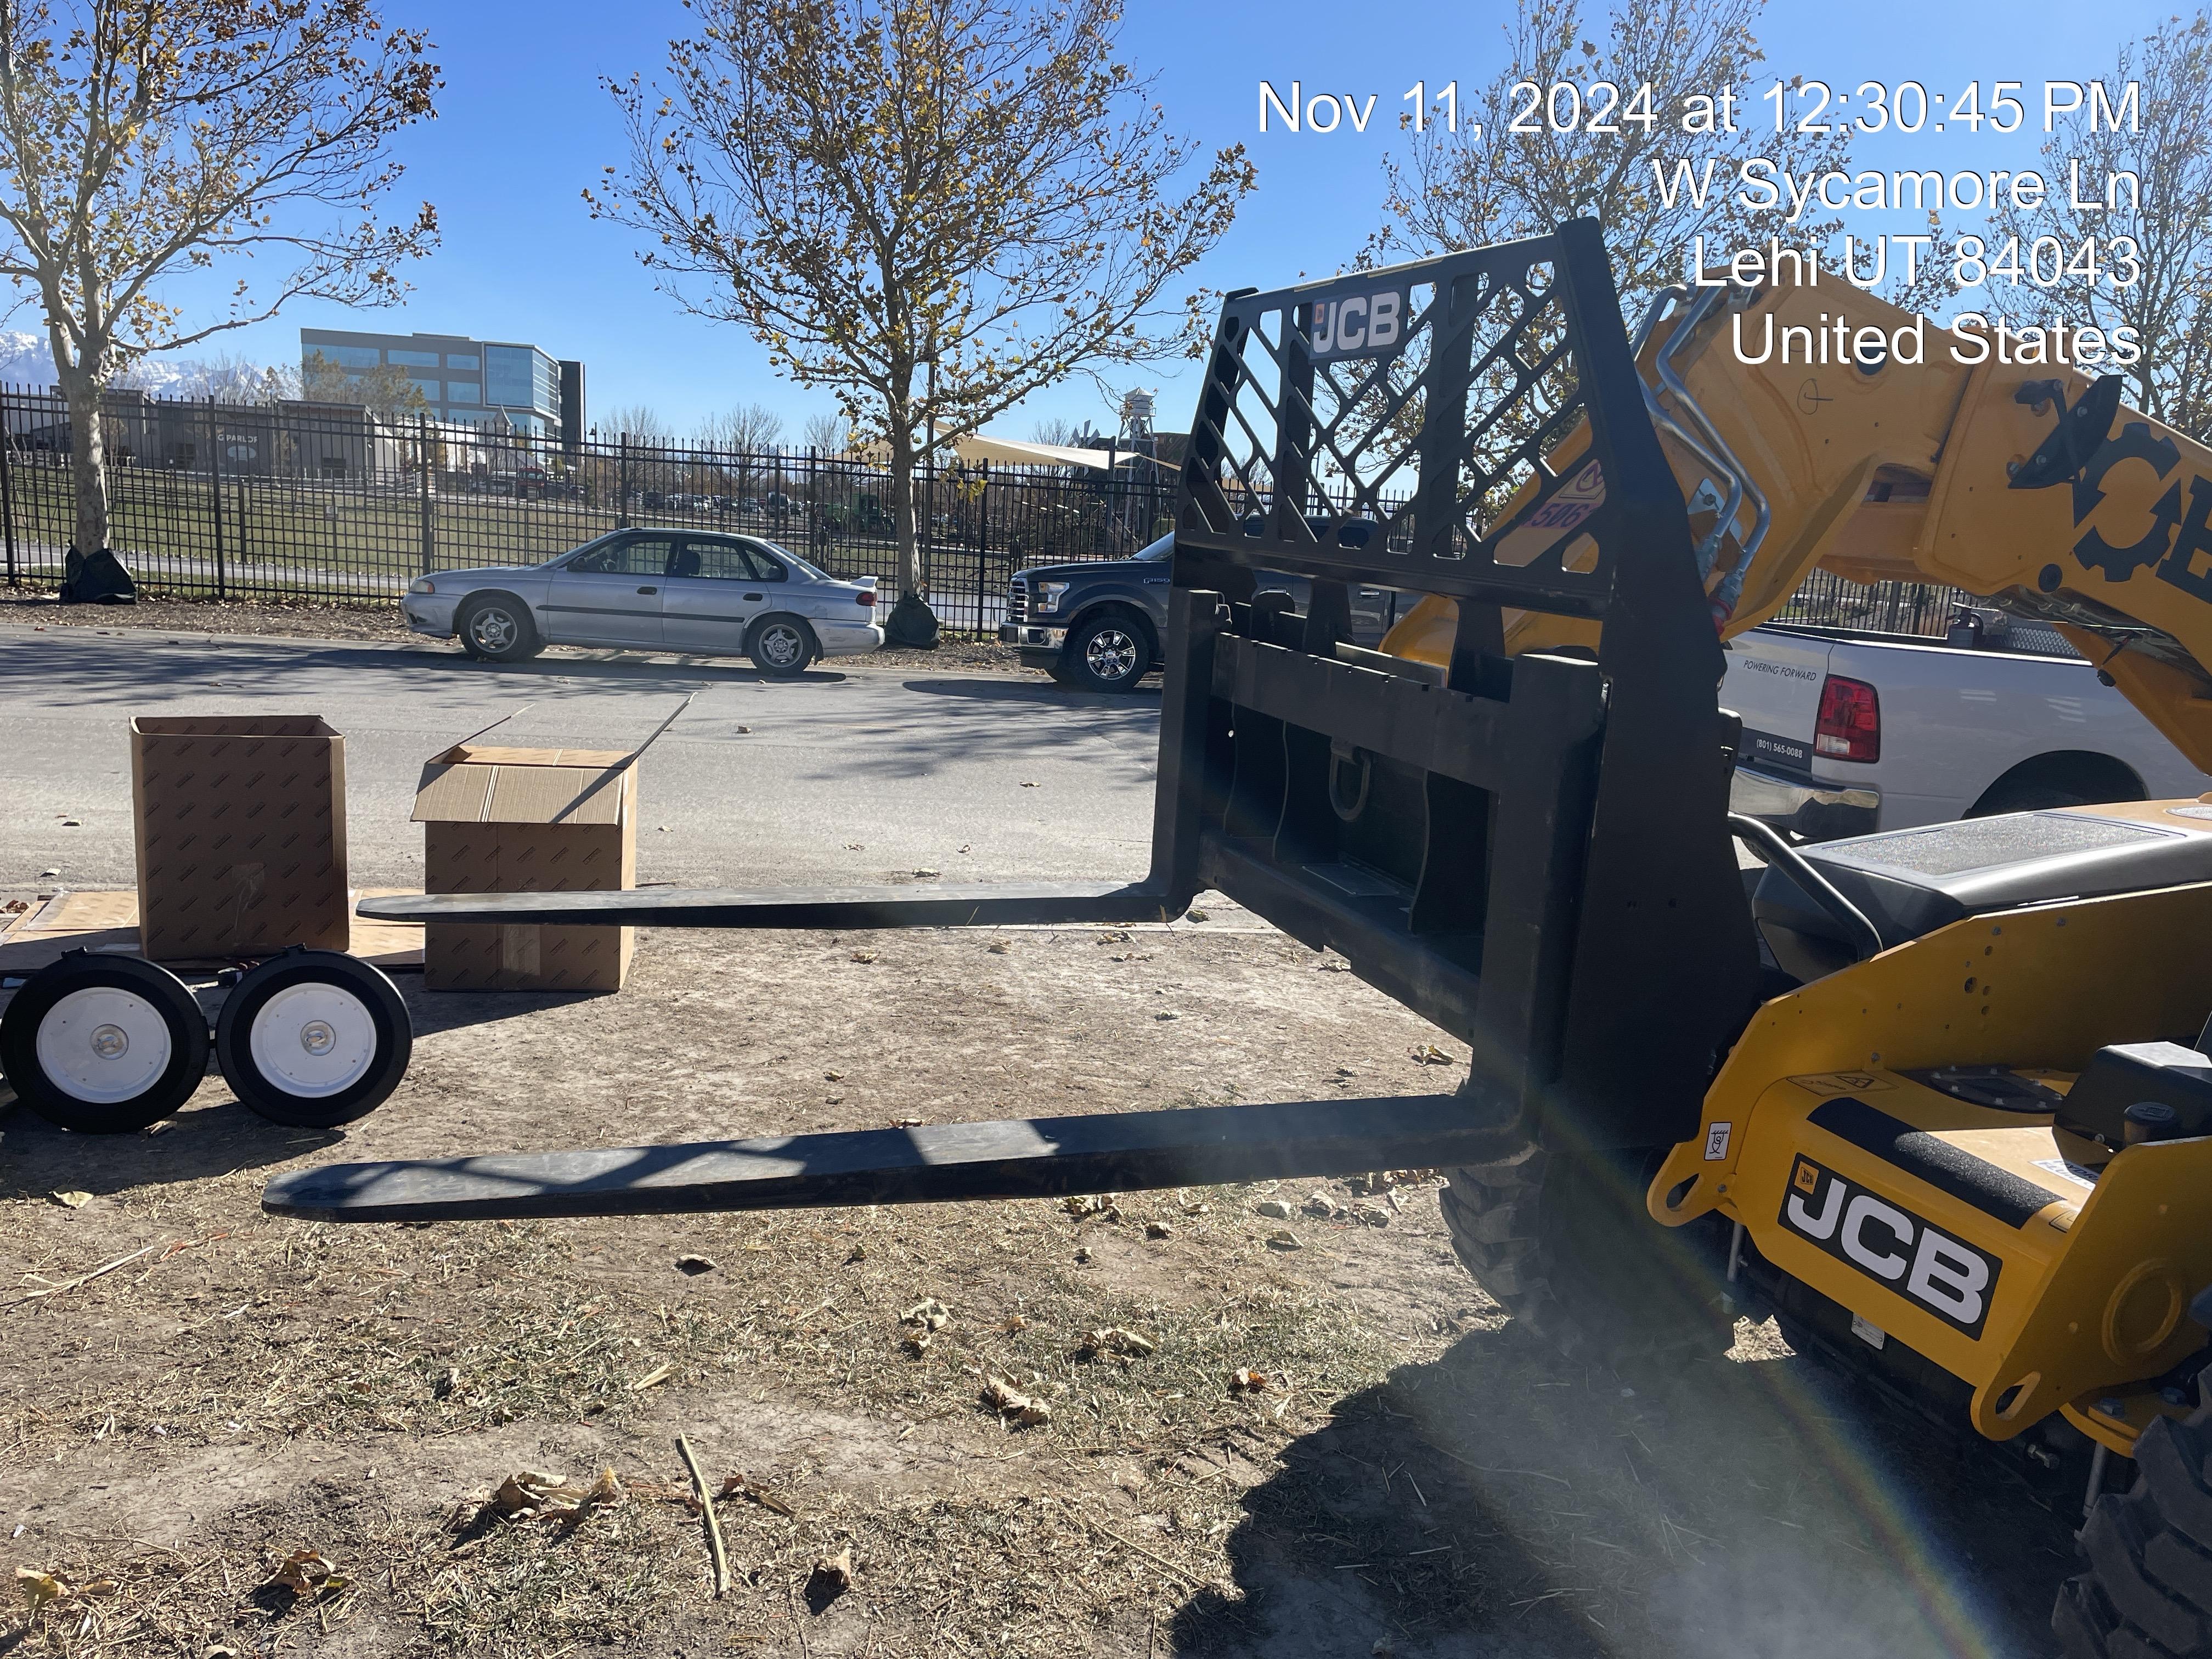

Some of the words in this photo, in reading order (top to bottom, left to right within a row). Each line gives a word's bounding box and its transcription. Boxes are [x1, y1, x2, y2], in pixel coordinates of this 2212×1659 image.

[1313, 292, 1400, 353] JCB
[1743, 660, 1779, 675] POWERING
[1780, 667, 1817, 681] FORWARD
[1756, 738, 1772, 752] (801)
[1773, 742, 1803, 759] 565-0088
[1787, 1177, 1989, 1324] JCB
